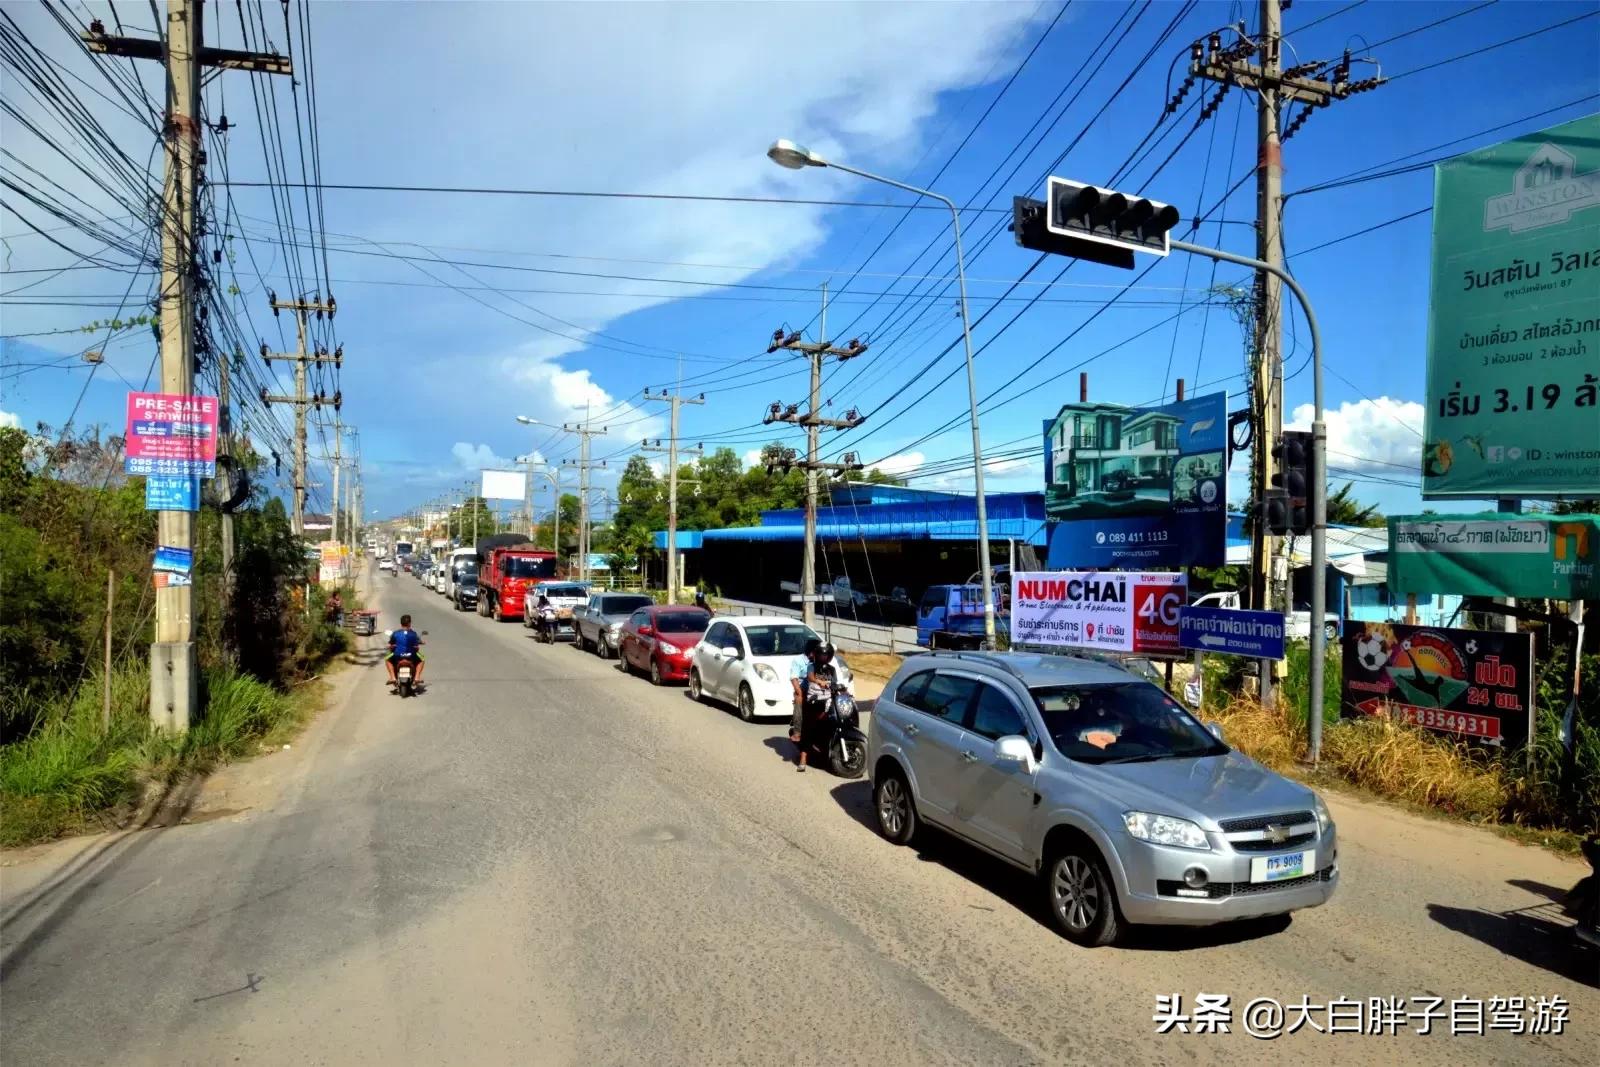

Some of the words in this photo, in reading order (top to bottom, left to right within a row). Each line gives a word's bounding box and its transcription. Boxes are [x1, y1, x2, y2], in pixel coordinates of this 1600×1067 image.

[1496, 182, 1595, 214] WINSTON
[1464, 259, 1540, 291] วินสตัน
[1460, 325, 1518, 350] บ้านเดี่ยว
[1483, 355, 1489, 367] 3
[1540, 347, 1547, 359] 2
[135, 397, 213, 413] PRE-SALE
[1439, 381, 1481, 417] เริ่ม
[1493, 384, 1561, 413] 3.19
[1574, 373, 1600, 408] ล้
[1526, 449, 1542, 461] ID
[1109, 533, 1126, 543] 089
[1128, 532, 1144, 542] 411
[1147, 530, 1168, 542] 1113
[1552, 561, 1593, 577] Parking
[1018, 579, 1127, 603] NUMCHAI
[1018, 600, 1037, 609] Home
[1076, 602, 1081, 610] &
[1083, 603, 1126, 613] Appliances
[1138, 592, 1180, 627] 4G
[1476, 655, 1516, 688] เปิด
[1467, 687, 1490, 705] 24
[1495, 692, 1523, 711] ชม.
